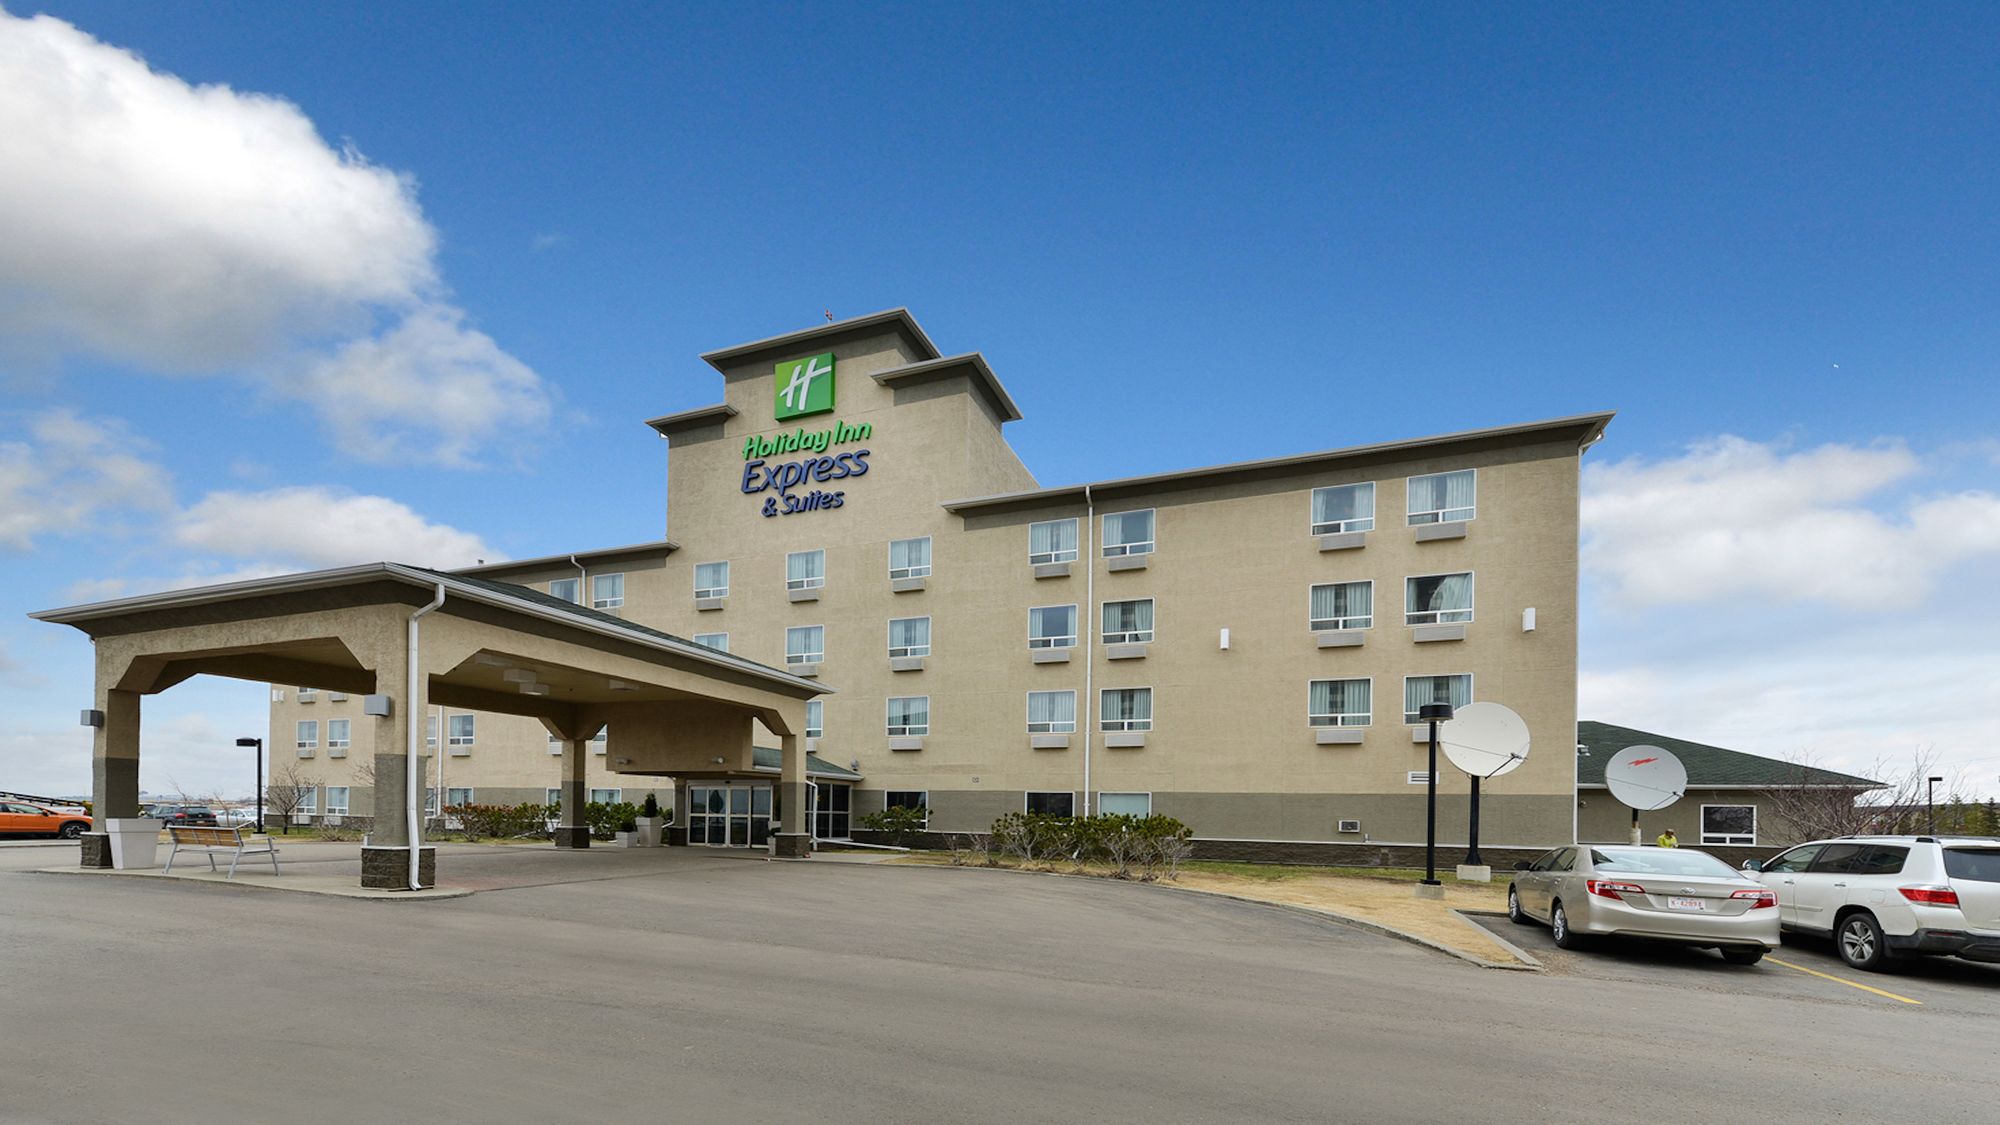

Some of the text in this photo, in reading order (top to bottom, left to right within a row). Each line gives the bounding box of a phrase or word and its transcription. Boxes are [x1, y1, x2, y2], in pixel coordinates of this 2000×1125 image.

[779, 358, 832, 411] H
[742, 419, 872, 460] Holiday Inn
[741, 449, 870, 496] Express
[761, 490, 844, 517] & Suites
